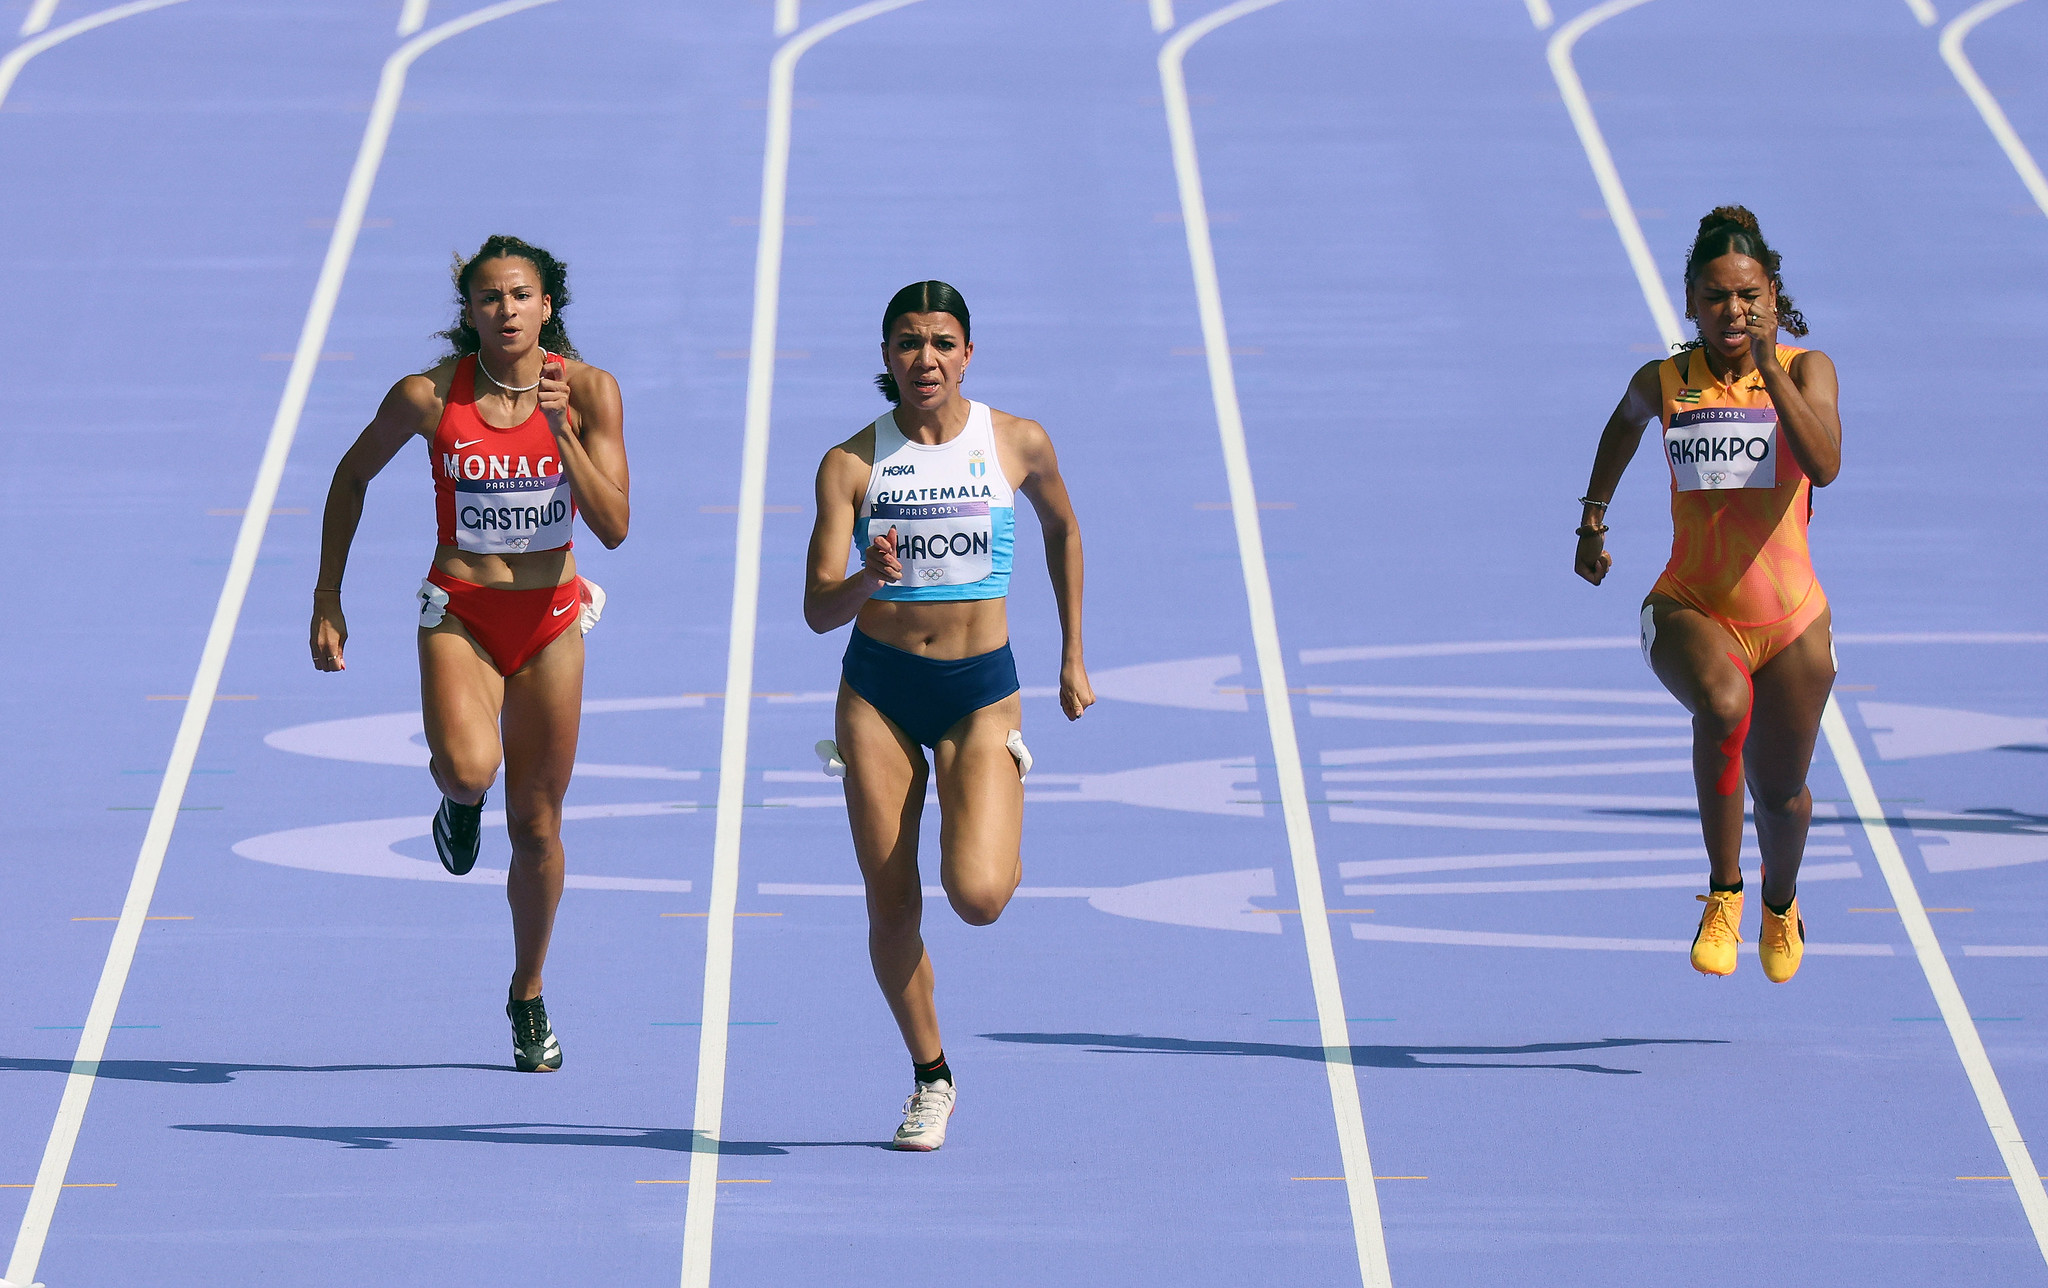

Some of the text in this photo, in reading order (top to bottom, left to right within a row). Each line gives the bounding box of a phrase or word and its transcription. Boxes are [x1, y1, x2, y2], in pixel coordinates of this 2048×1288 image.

[1691, 411, 1746, 420] PARIS 2024
[1669, 436, 1769, 465] AKAKPO
[881, 464, 915, 477] HOKA
[485, 479, 546, 490] PARIS 2024
[876, 485, 992, 504] GUATEMALA
[460, 499, 567, 530] GASTAUD
[899, 506, 958, 516] PARIS 2024
[878, 531, 988, 560] HACON
